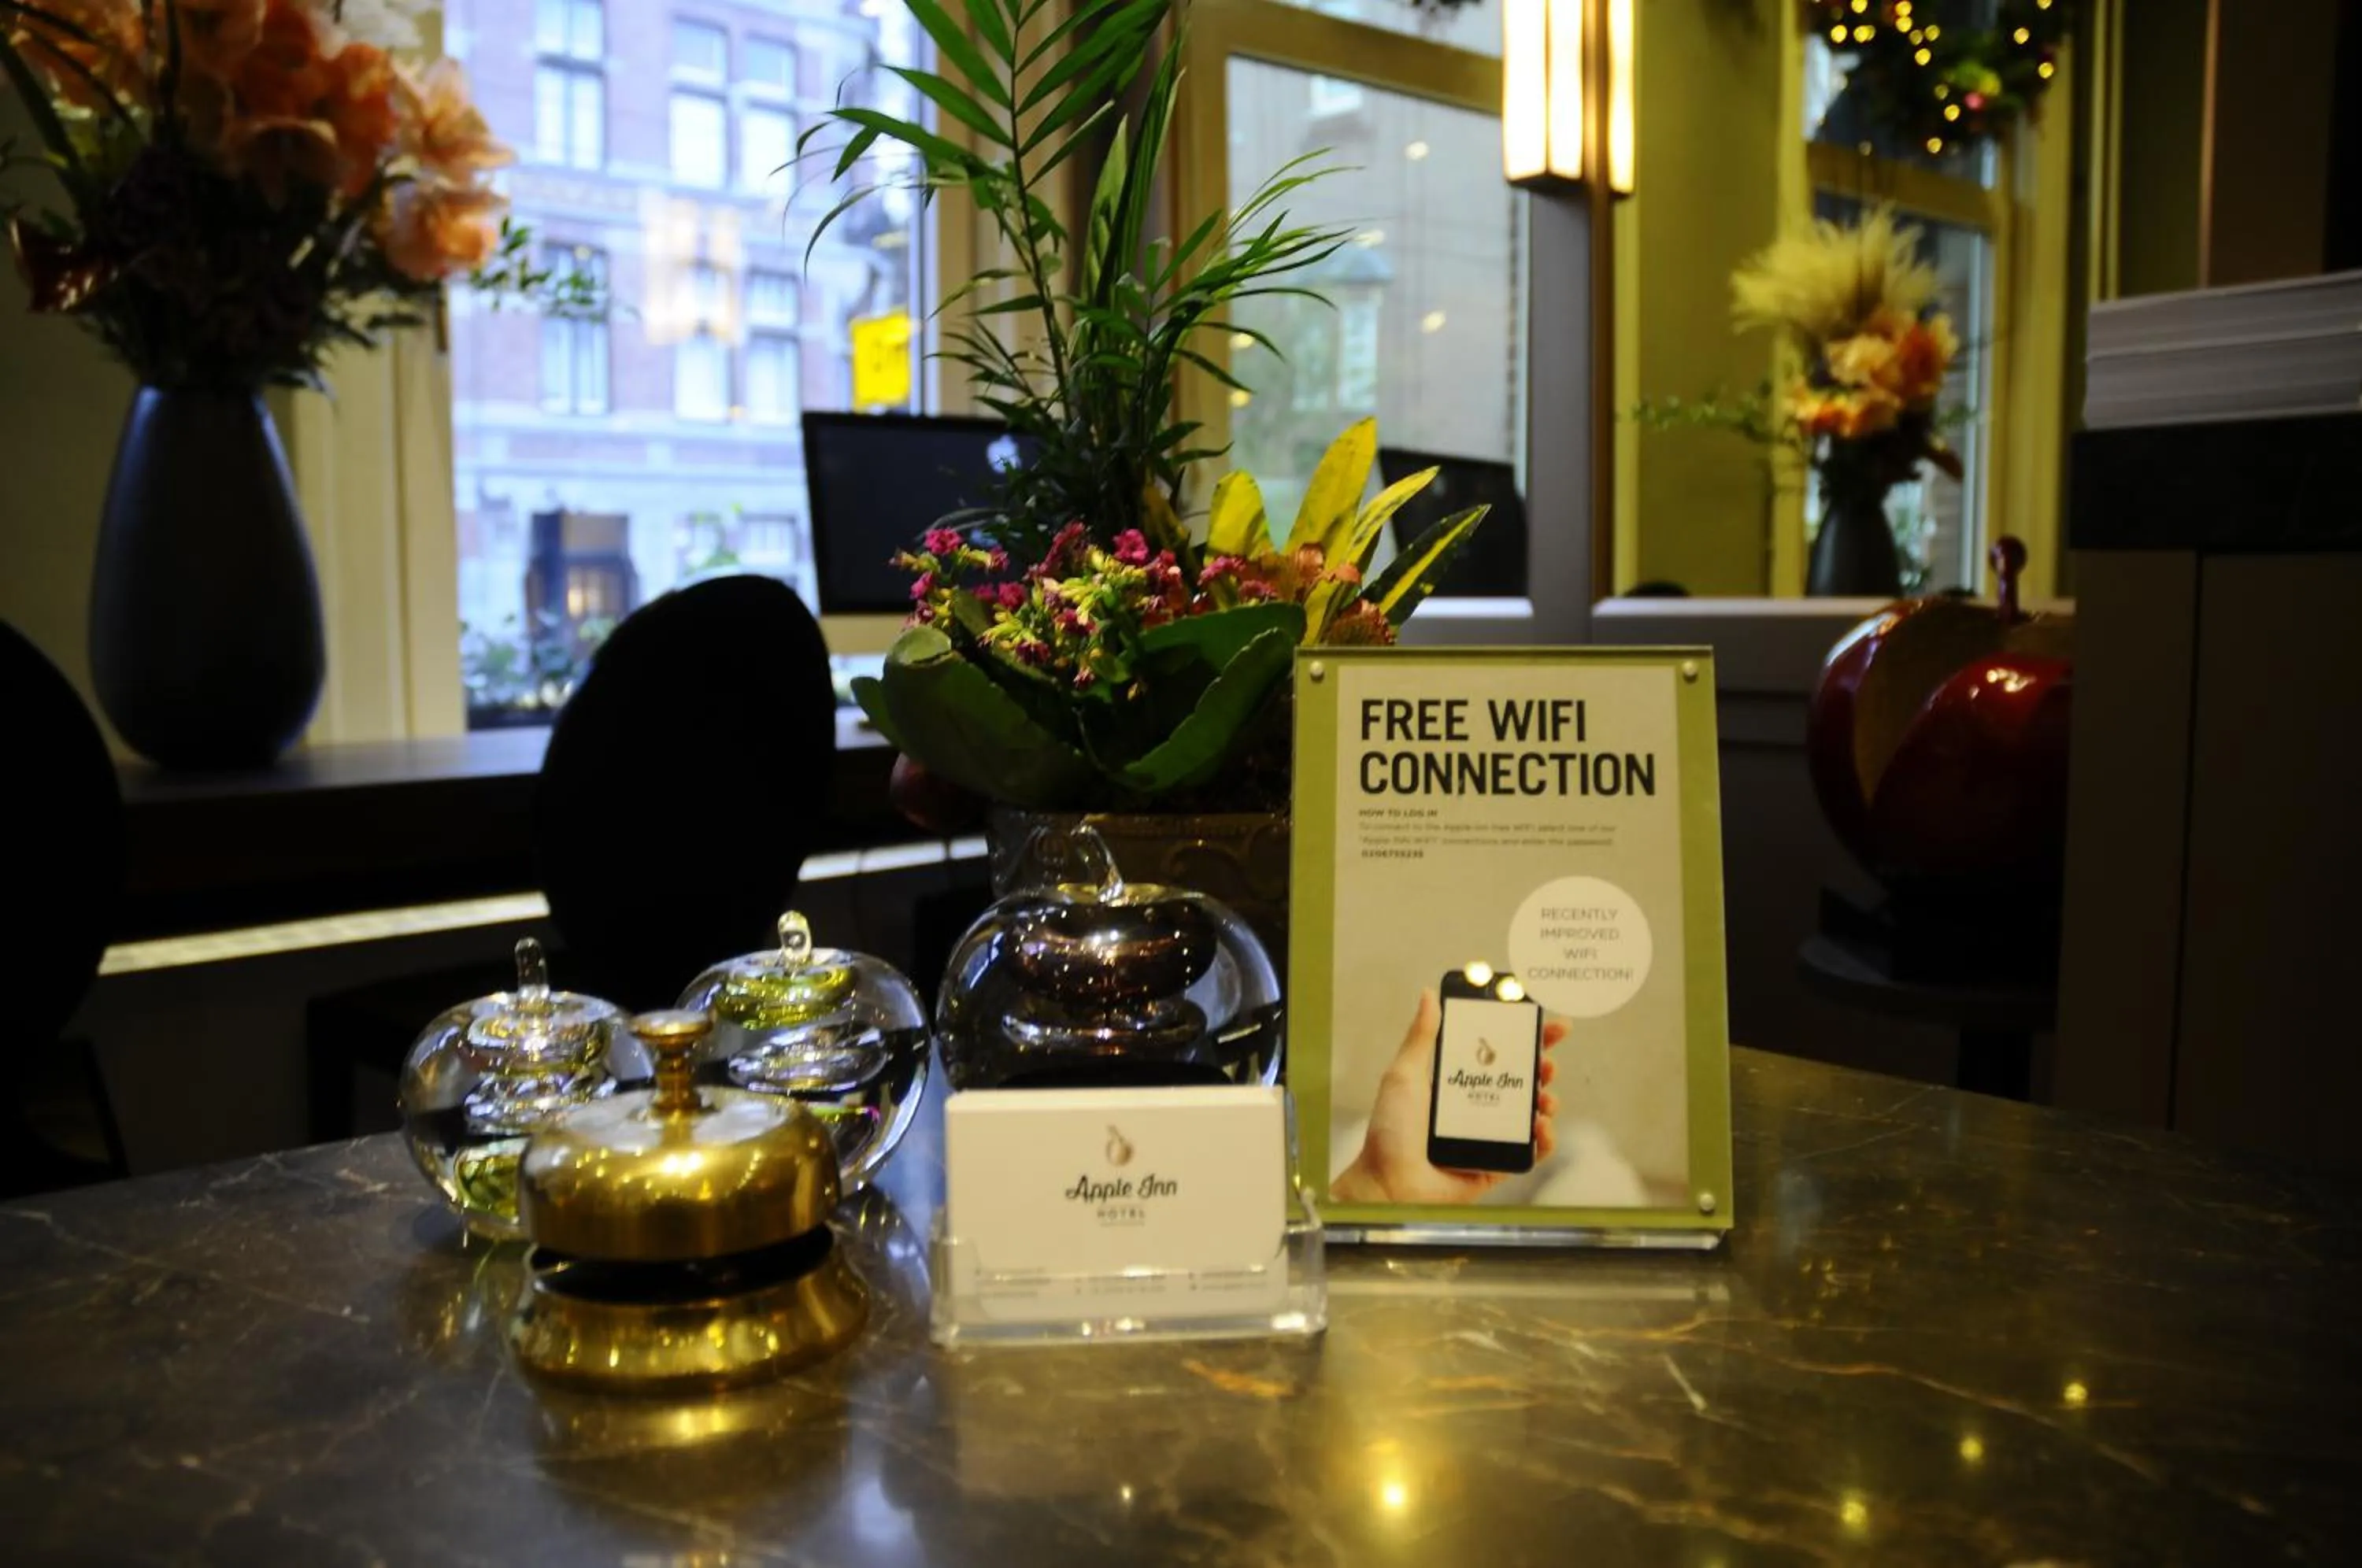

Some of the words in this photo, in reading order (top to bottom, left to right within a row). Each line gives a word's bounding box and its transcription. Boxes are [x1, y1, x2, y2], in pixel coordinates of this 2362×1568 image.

[1361, 698, 1469, 741] FREE
[1488, 699, 1586, 741] WIFI
[1360, 751, 1656, 796] CONNECTION
[1358, 808, 1385, 817] HOW
[1387, 808, 1401, 817] TO
[1403, 808, 1424, 818] LOG
[1541, 907, 1618, 920] RECENTLY
[1540, 927, 1620, 940] IMPROVED
[1563, 947, 1599, 960] WIFI
[1527, 967, 1635, 981] CONNECTION!
[1447, 1068, 1494, 1089] Apple
[1497, 1071, 1524, 1090] Inn
[1064, 1174, 1132, 1204] Apple
[1137, 1172, 1178, 1200] Inn
[1097, 1207, 1146, 1219] HOTEL
